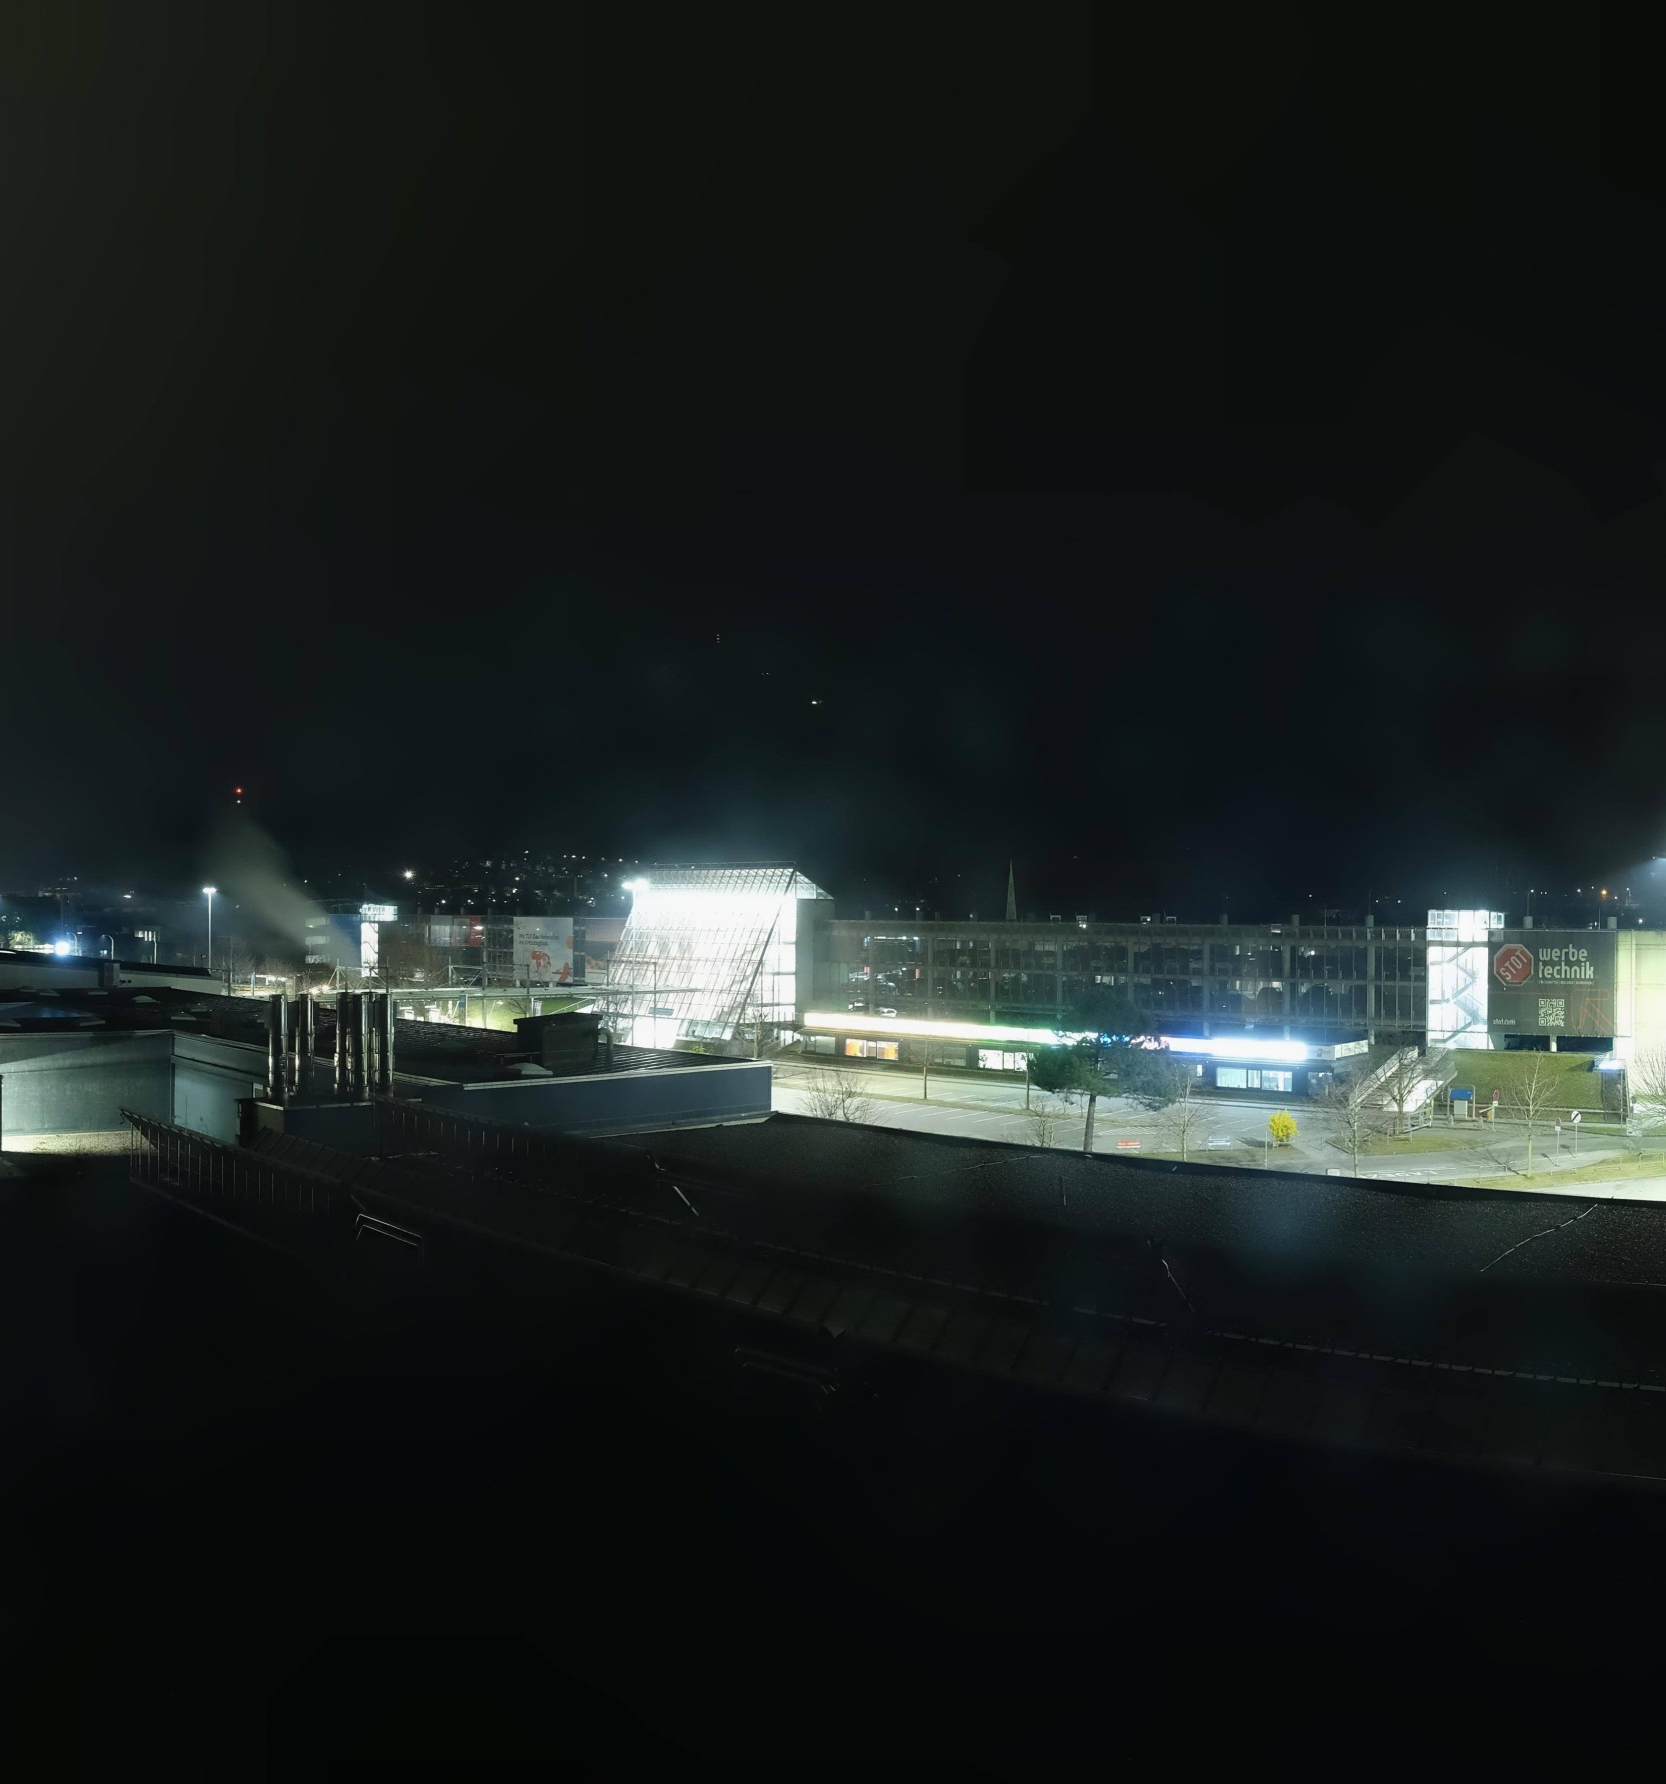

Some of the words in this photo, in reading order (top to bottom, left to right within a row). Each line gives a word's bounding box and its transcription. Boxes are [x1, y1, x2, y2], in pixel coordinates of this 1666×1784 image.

[1539, 944, 1588, 961] werbe
[1500, 950, 1528, 980] STOT
[1539, 962, 1594, 979] technik
